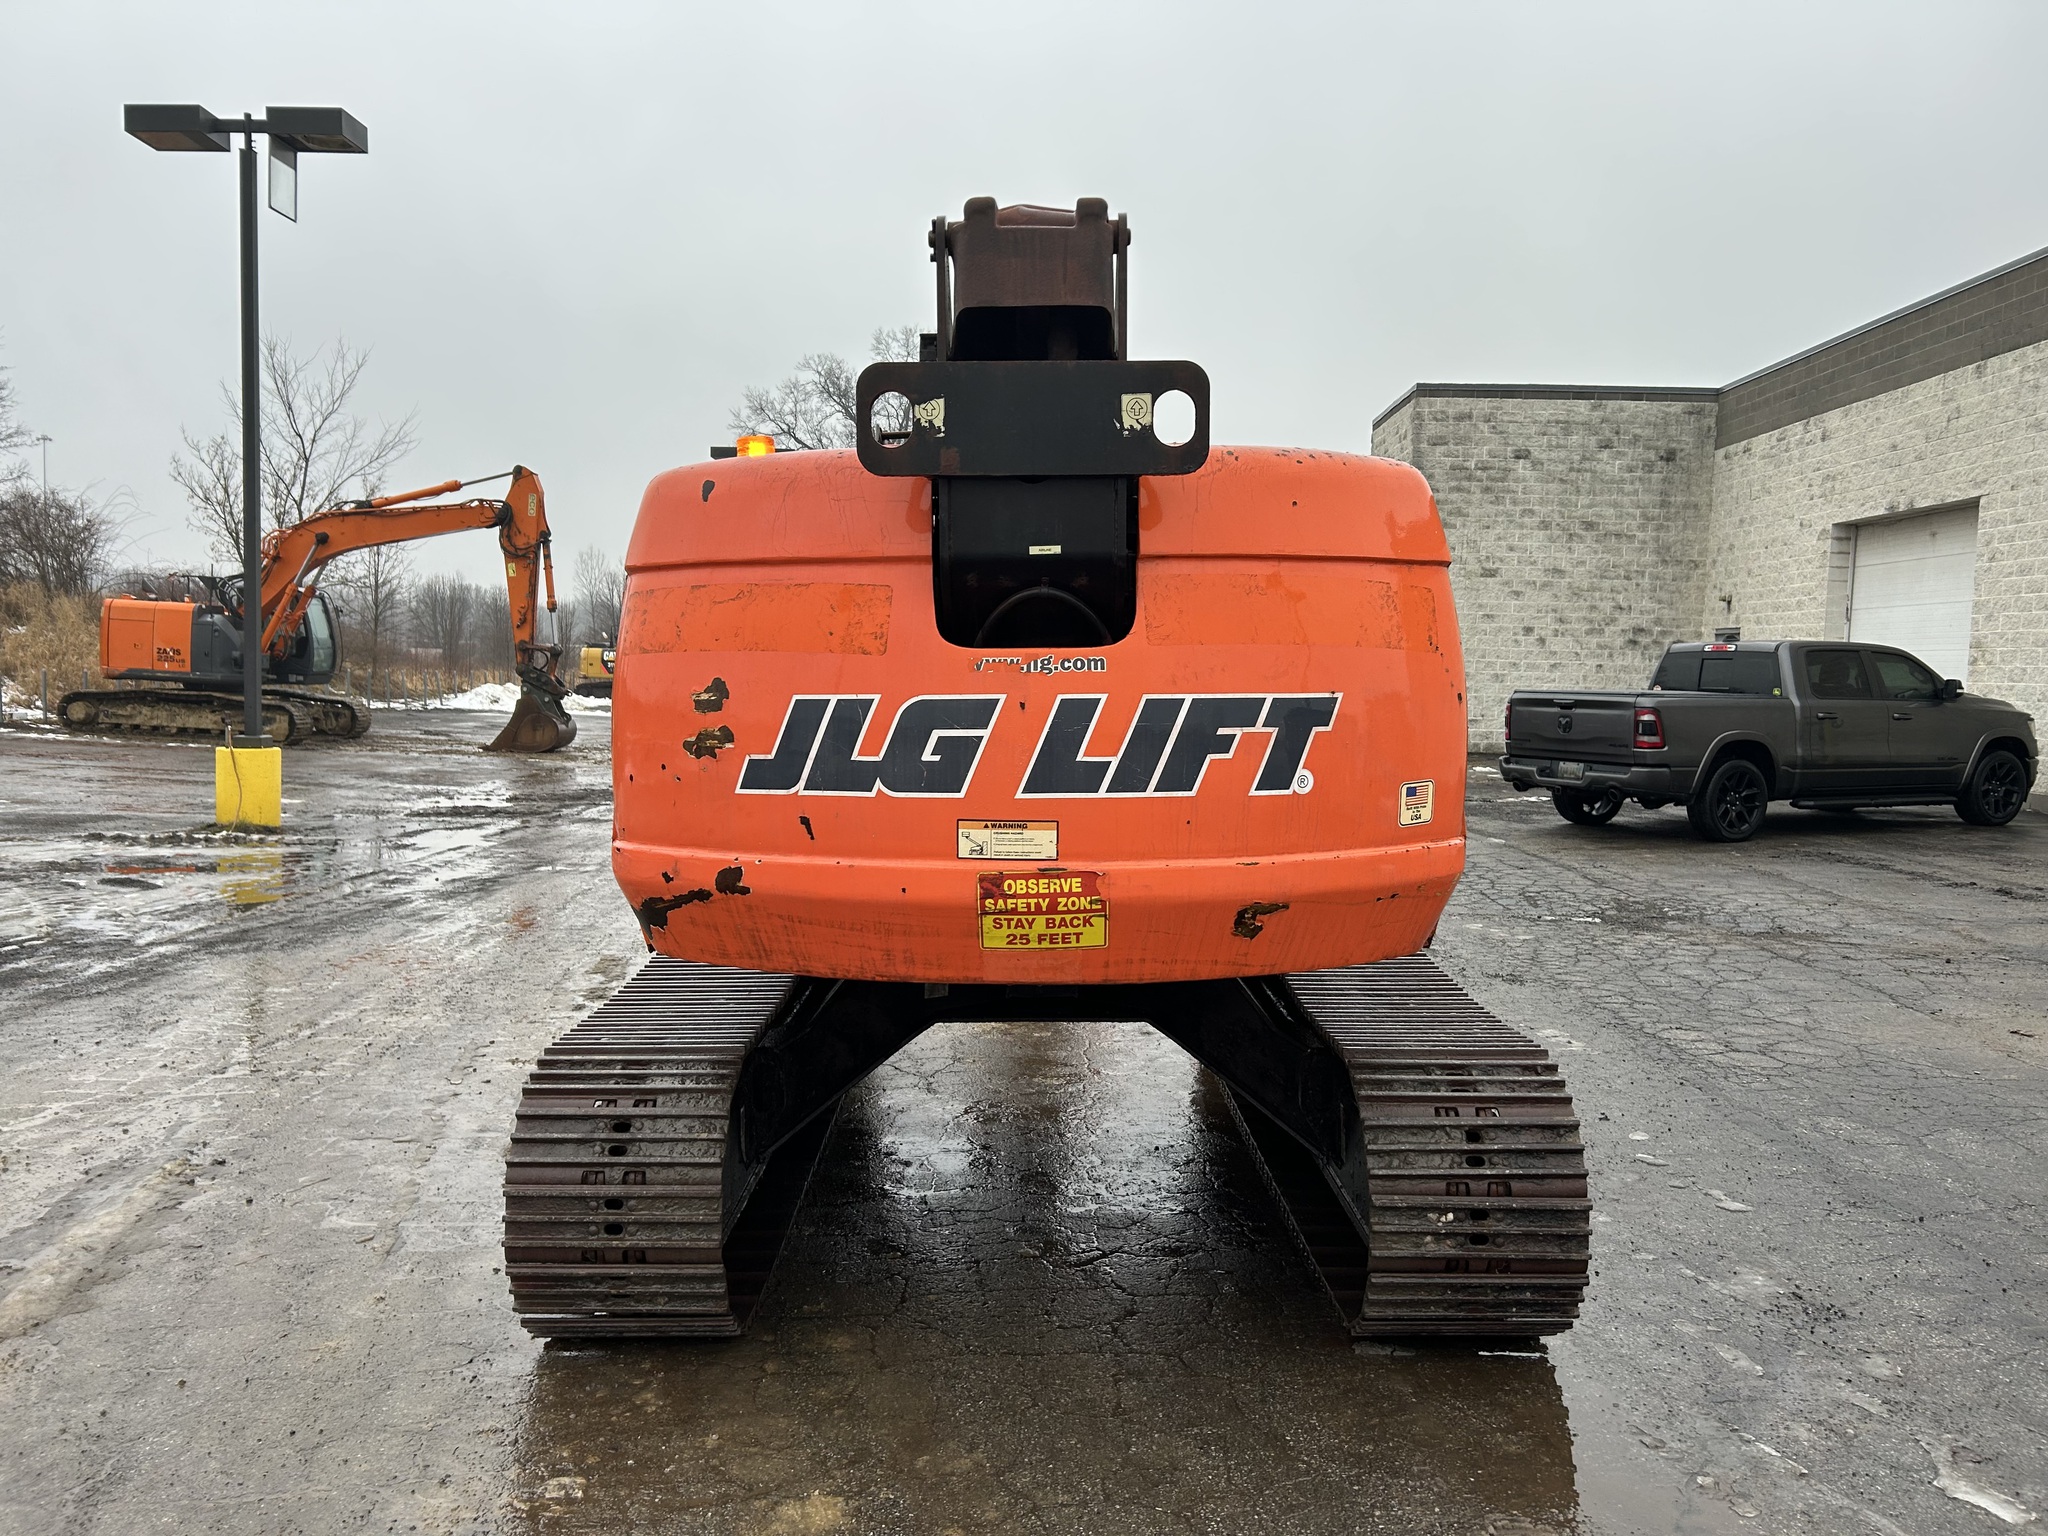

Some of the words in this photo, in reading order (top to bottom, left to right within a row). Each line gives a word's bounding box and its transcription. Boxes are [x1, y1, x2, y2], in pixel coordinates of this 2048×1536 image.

[735, 694, 1007, 798] JLG
[1410, 813, 1422, 821] USA
[1003, 878, 1083, 895] OBSERVE
[984, 898, 1050, 912] SAFETY
[1057, 896, 1102, 911] ZONE
[992, 917, 1037, 930] STAY
[1045, 916, 1095, 930] BACK
[1005, 933, 1031, 946] 25
[1037, 932, 1084, 945] FEET
